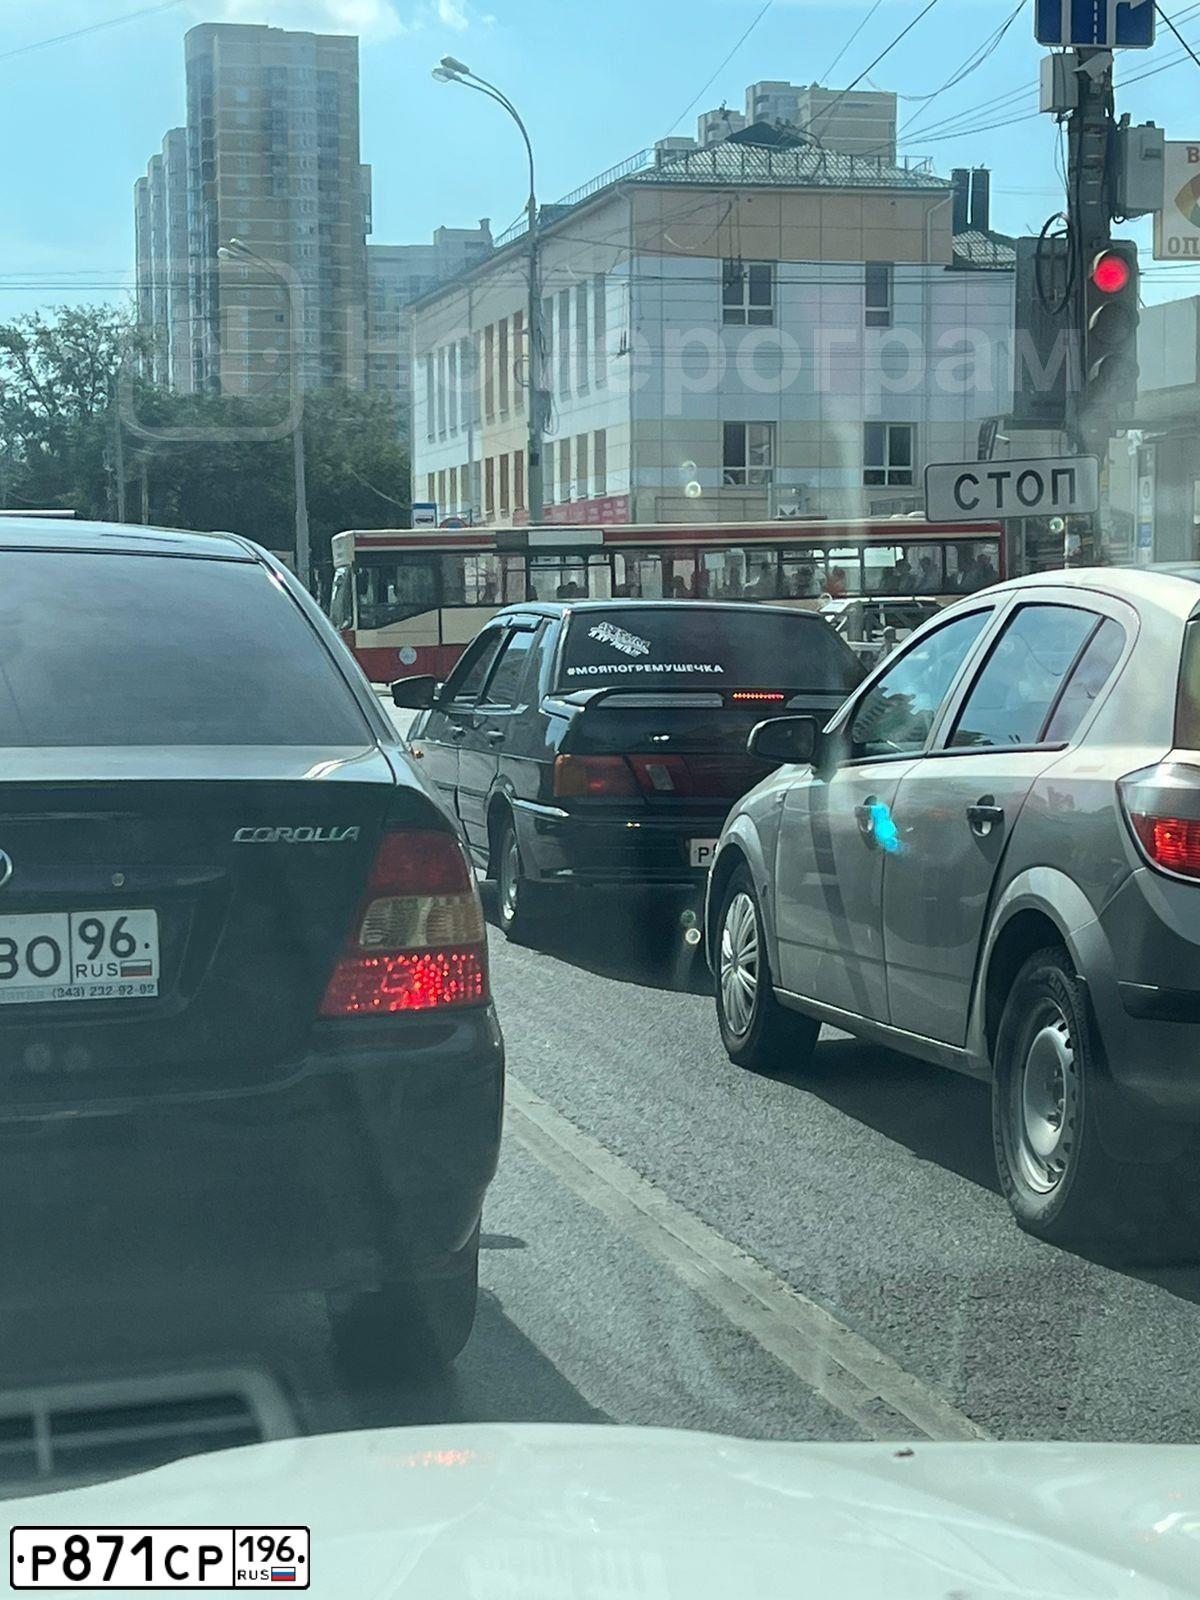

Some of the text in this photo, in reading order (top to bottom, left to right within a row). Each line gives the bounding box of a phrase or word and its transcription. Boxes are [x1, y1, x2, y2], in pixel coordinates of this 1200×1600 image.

[953, 467, 1076, 511] СТОП
[566, 663, 724, 676] #МОЯПОГРЕМУШЕЧКА
[232, 826, 360, 843] COROLLA
[78, 916, 137, 960] 96
[76, 963, 118, 978] RUS
